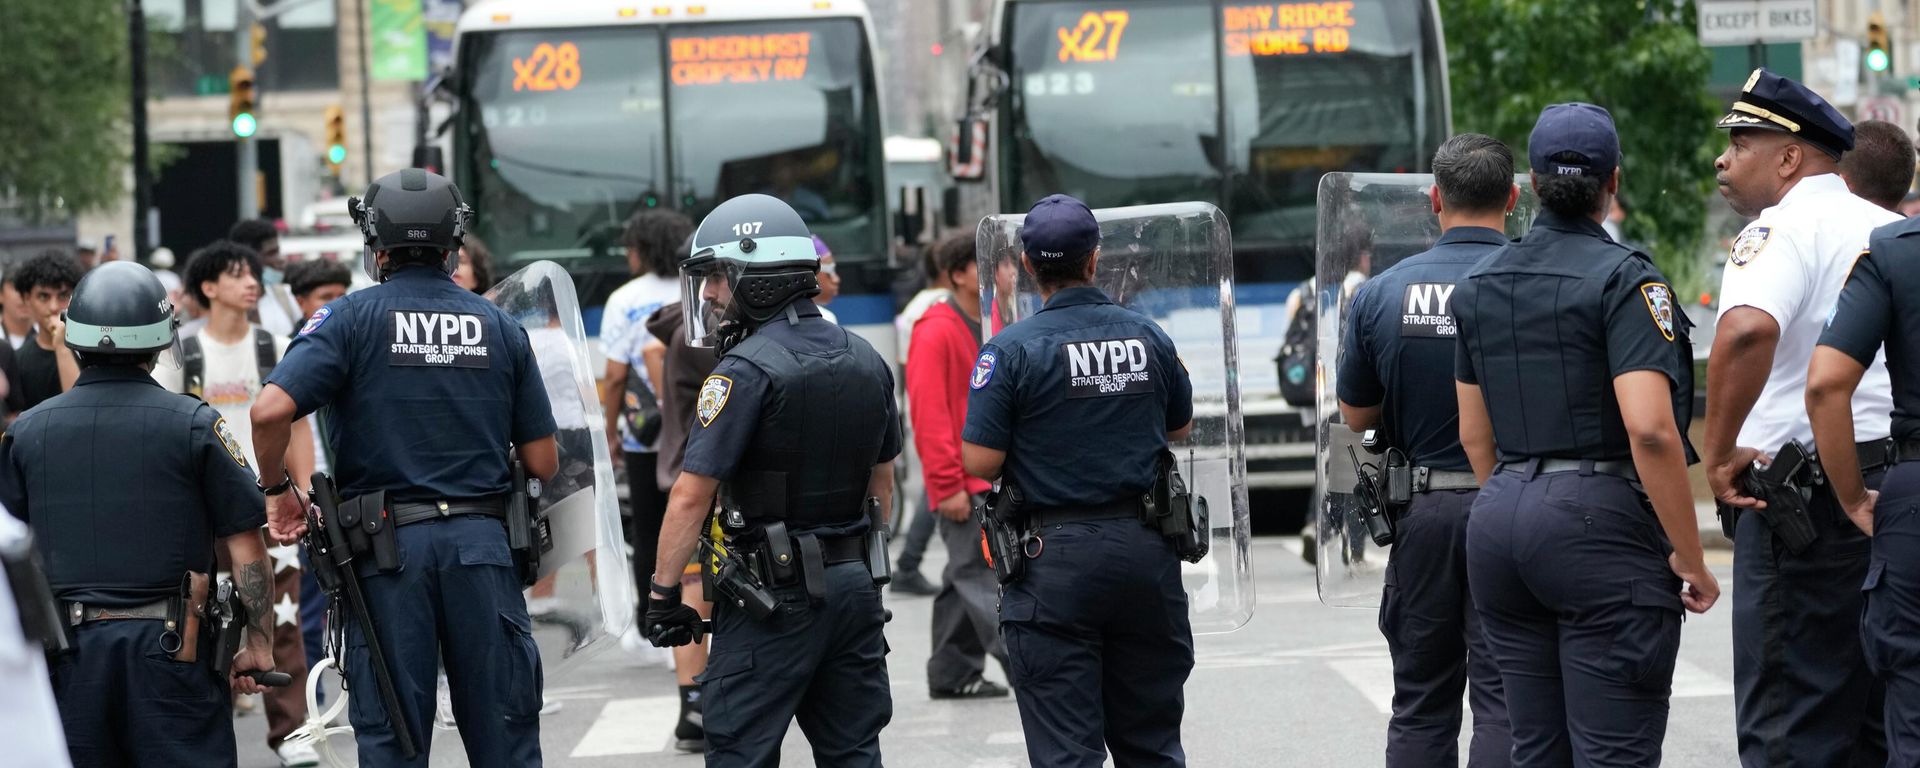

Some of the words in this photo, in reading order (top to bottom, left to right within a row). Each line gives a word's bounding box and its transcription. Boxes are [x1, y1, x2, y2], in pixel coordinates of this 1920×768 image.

[1223, 6, 1273, 31] BAY
[1278, 1, 1355, 28] RIDGE
[1705, 12, 1759, 30] EXCEPT
[1768, 8, 1812, 28] BIKES
[1057, 10, 1129, 63] x27
[1224, 29, 1309, 56] SHORE
[1313, 27, 1350, 53] RD
[512, 41, 582, 93] x28
[672, 58, 772, 86] CROPSEY
[774, 57, 807, 82] AV
[1557, 166, 1582, 176] NYPD
[408, 230, 427, 239] SRG
[732, 221, 763, 236] 107
[1041, 250, 1064, 258] NYPD
[395, 311, 482, 345] NYPD
[1403, 315, 1450, 325] STRATEGIC
[391, 343, 440, 355] STRATEGIC
[442, 345, 488, 356] RESPONSE
[425, 354, 455, 364] GROUP
[1067, 339, 1148, 377] NYPD
[1071, 374, 1112, 387] STRATEGIC
[1112, 371, 1149, 384] RESPONSE
[1099, 382, 1126, 393] GROUP
